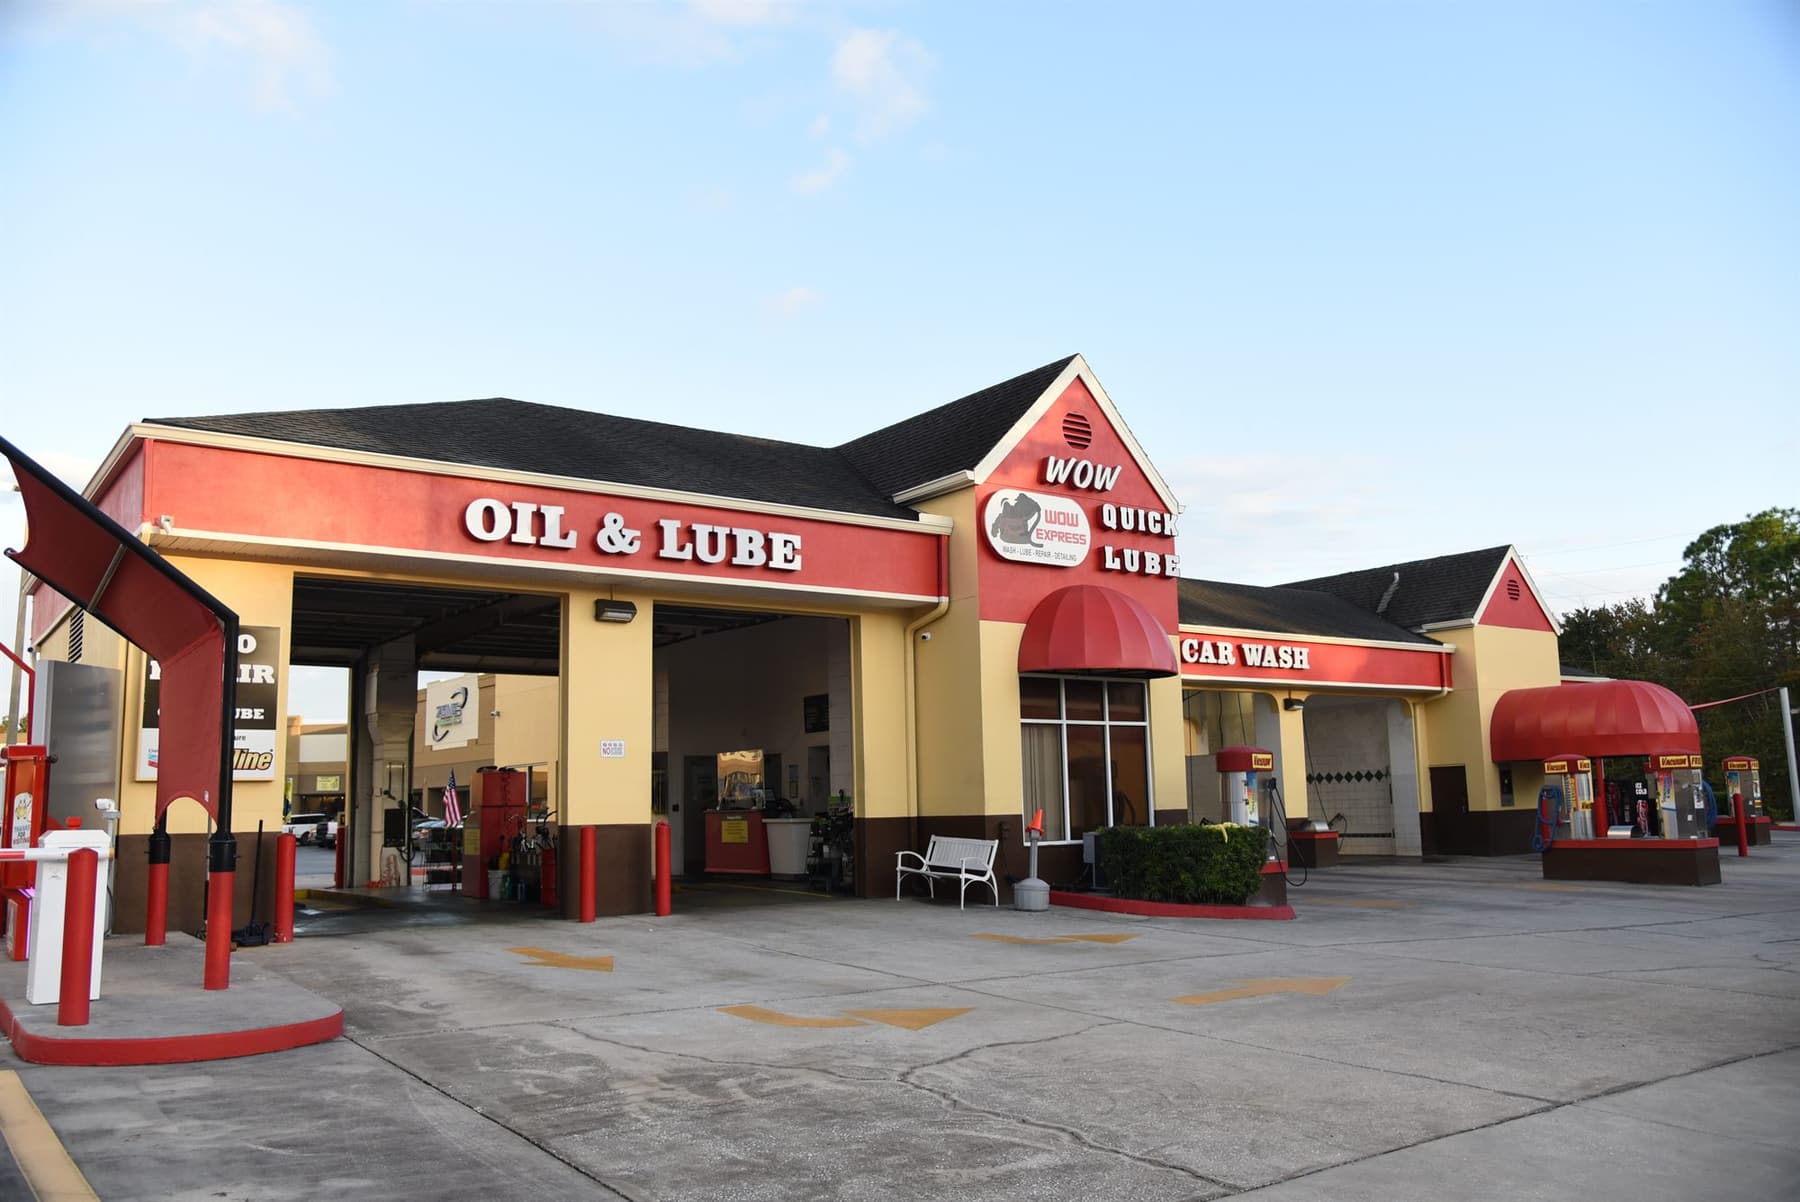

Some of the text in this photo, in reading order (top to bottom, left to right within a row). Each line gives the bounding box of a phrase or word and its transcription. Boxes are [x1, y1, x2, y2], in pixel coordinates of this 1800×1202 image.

[1045, 455, 1122, 491] WOW
[1044, 509, 1079, 527] WOW
[1102, 503, 1179, 536] QUICK
[465, 497, 802, 571] OIL & LUBE
[1036, 528, 1087, 545] EXPRESS
[1054, 552, 1077, 561] DETAILING
[1104, 545, 1181, 577] LUBE
[1181, 638, 1310, 669] CAR WASH
